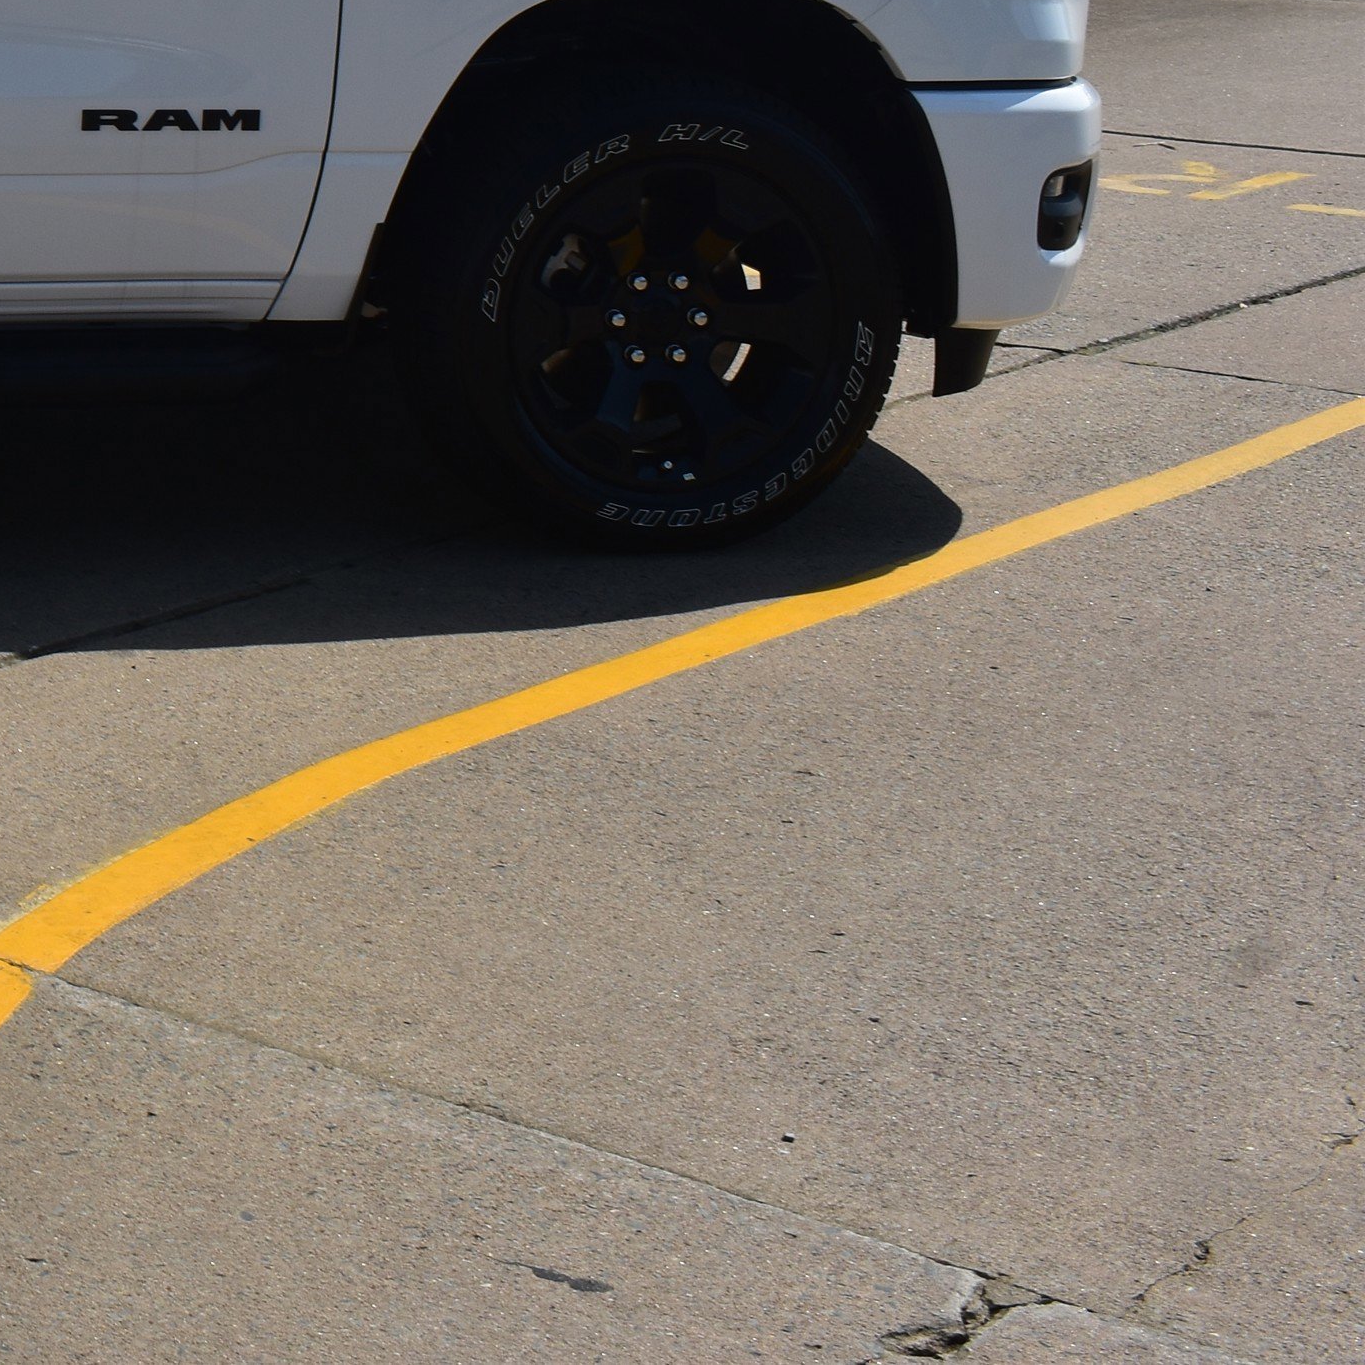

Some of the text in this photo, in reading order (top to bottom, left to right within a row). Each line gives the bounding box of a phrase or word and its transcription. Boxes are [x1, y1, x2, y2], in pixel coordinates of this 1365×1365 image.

[81, 109, 261, 131] RAM
[481, 123, 749, 323] DUELER H/L
[597, 321, 875, 528] BRIDGESTONE
